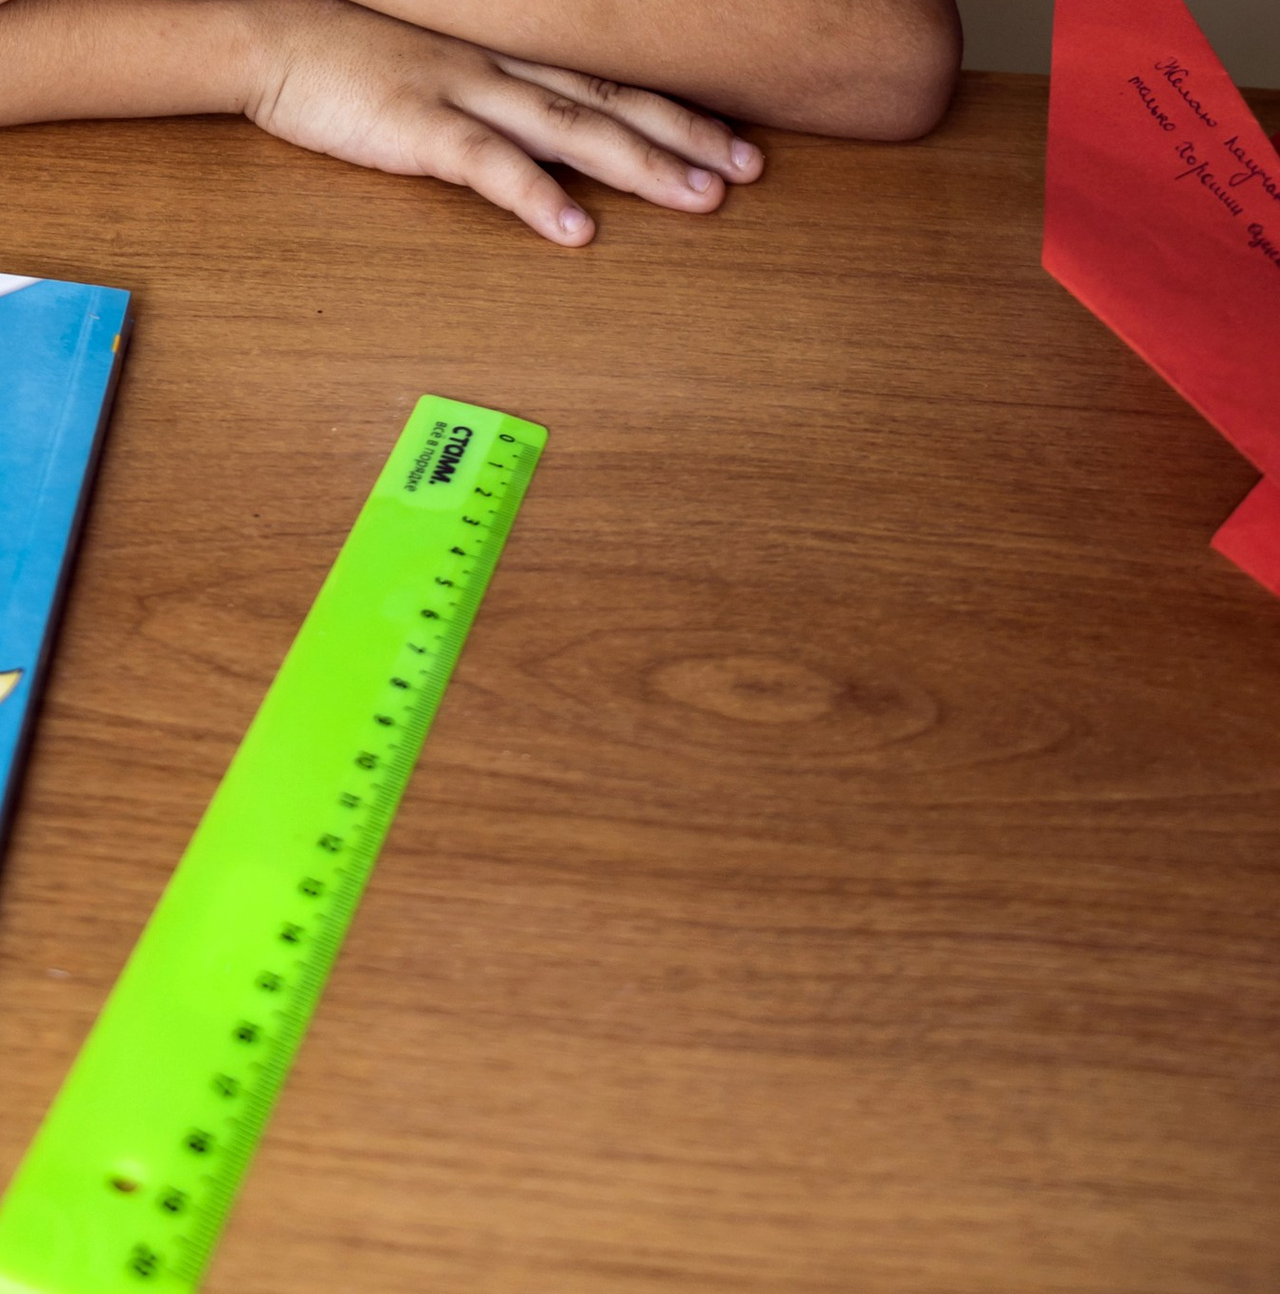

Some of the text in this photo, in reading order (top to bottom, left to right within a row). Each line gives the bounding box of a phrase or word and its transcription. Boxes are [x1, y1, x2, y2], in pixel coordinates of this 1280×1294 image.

[498, 433, 516, 444] 0
[404, 448, 435, 493] порядке
[487, 461, 504, 469] 1
[474, 486, 492, 498] 2
[462, 515, 480, 527] 3
[449, 545, 467, 557] 4
[434, 576, 454, 588] 5
[420, 608, 441, 621] 6
[406, 642, 426, 655] 7
